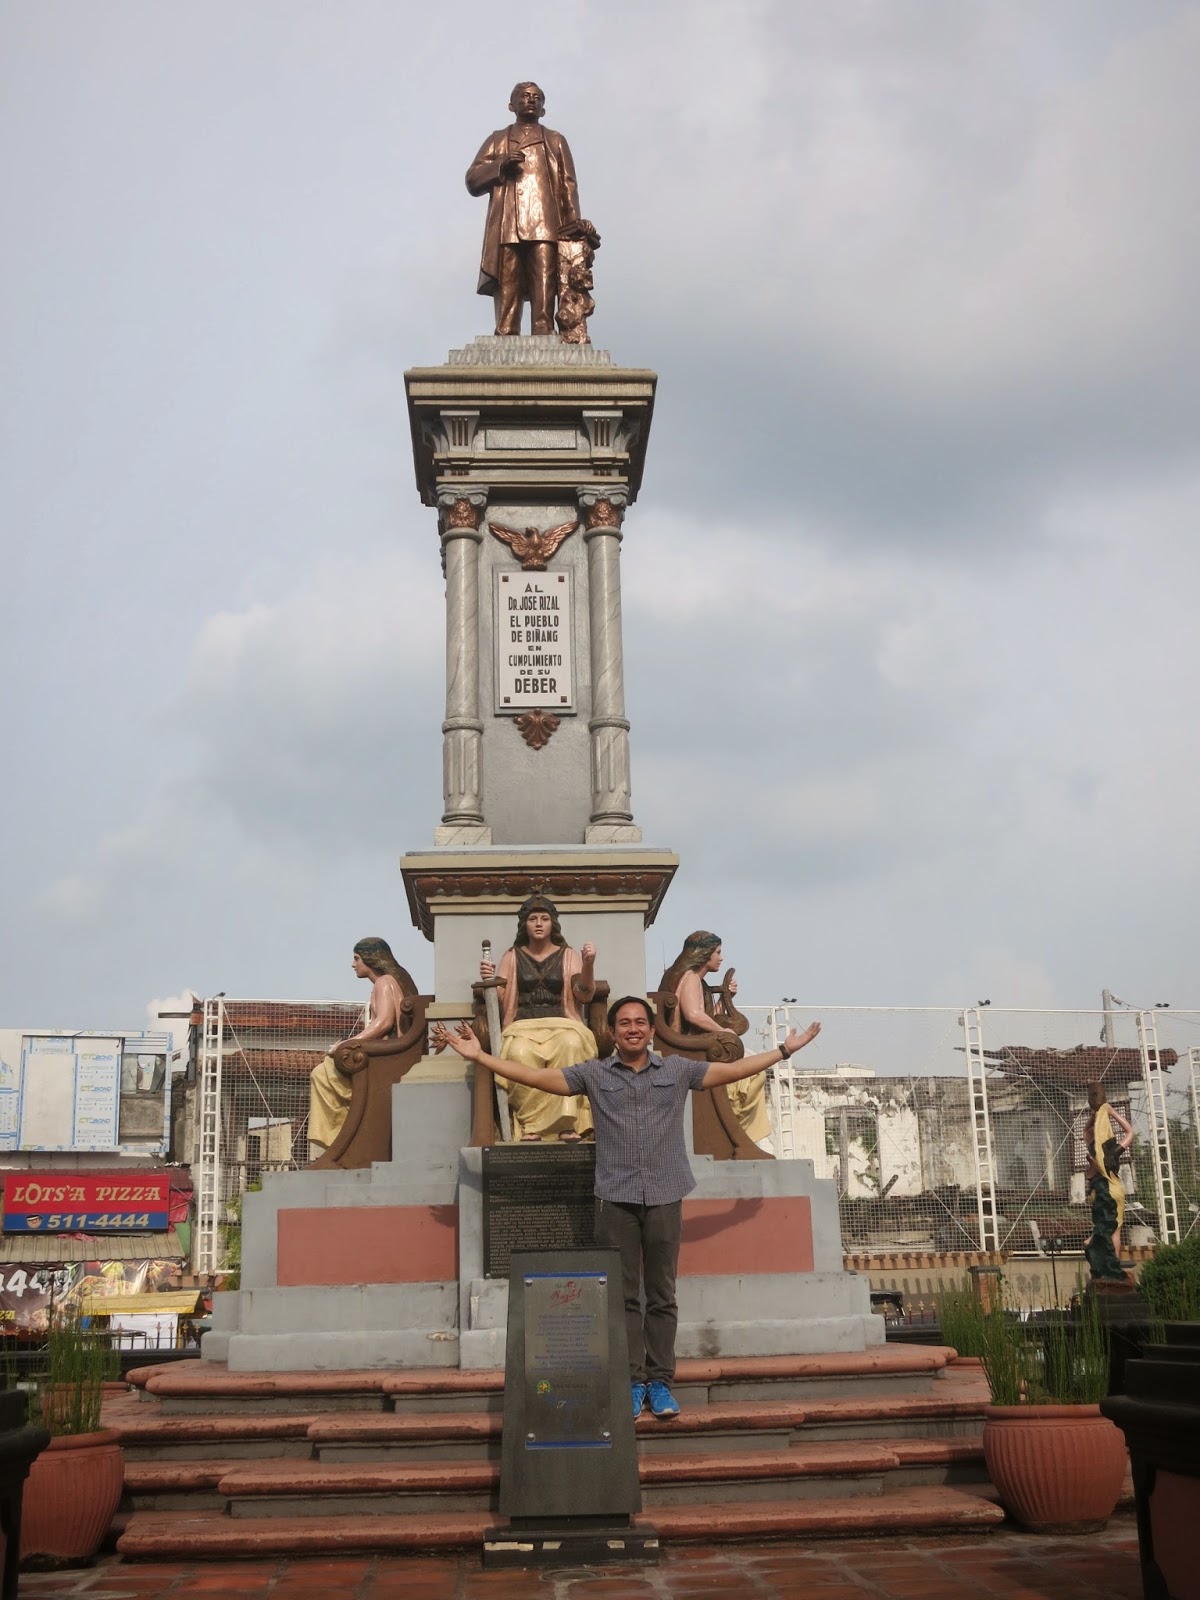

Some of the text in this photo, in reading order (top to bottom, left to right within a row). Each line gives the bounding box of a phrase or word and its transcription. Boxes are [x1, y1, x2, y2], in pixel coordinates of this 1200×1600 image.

[524, 582, 543, 593] AL
[519, 595, 538, 611] JOSE
[539, 595, 560, 611] RIZAL
[510, 615, 560, 628] EL PUEBLO
[511, 628, 558, 643] DE BIÑANG
[508, 654, 562, 667] CUMPLIMIENTO
[514, 678, 557, 693] DEBER
[12, 1182, 161, 1205] LOTS'A PIZZA
[47, 1213, 150, 1228] 511-4444
